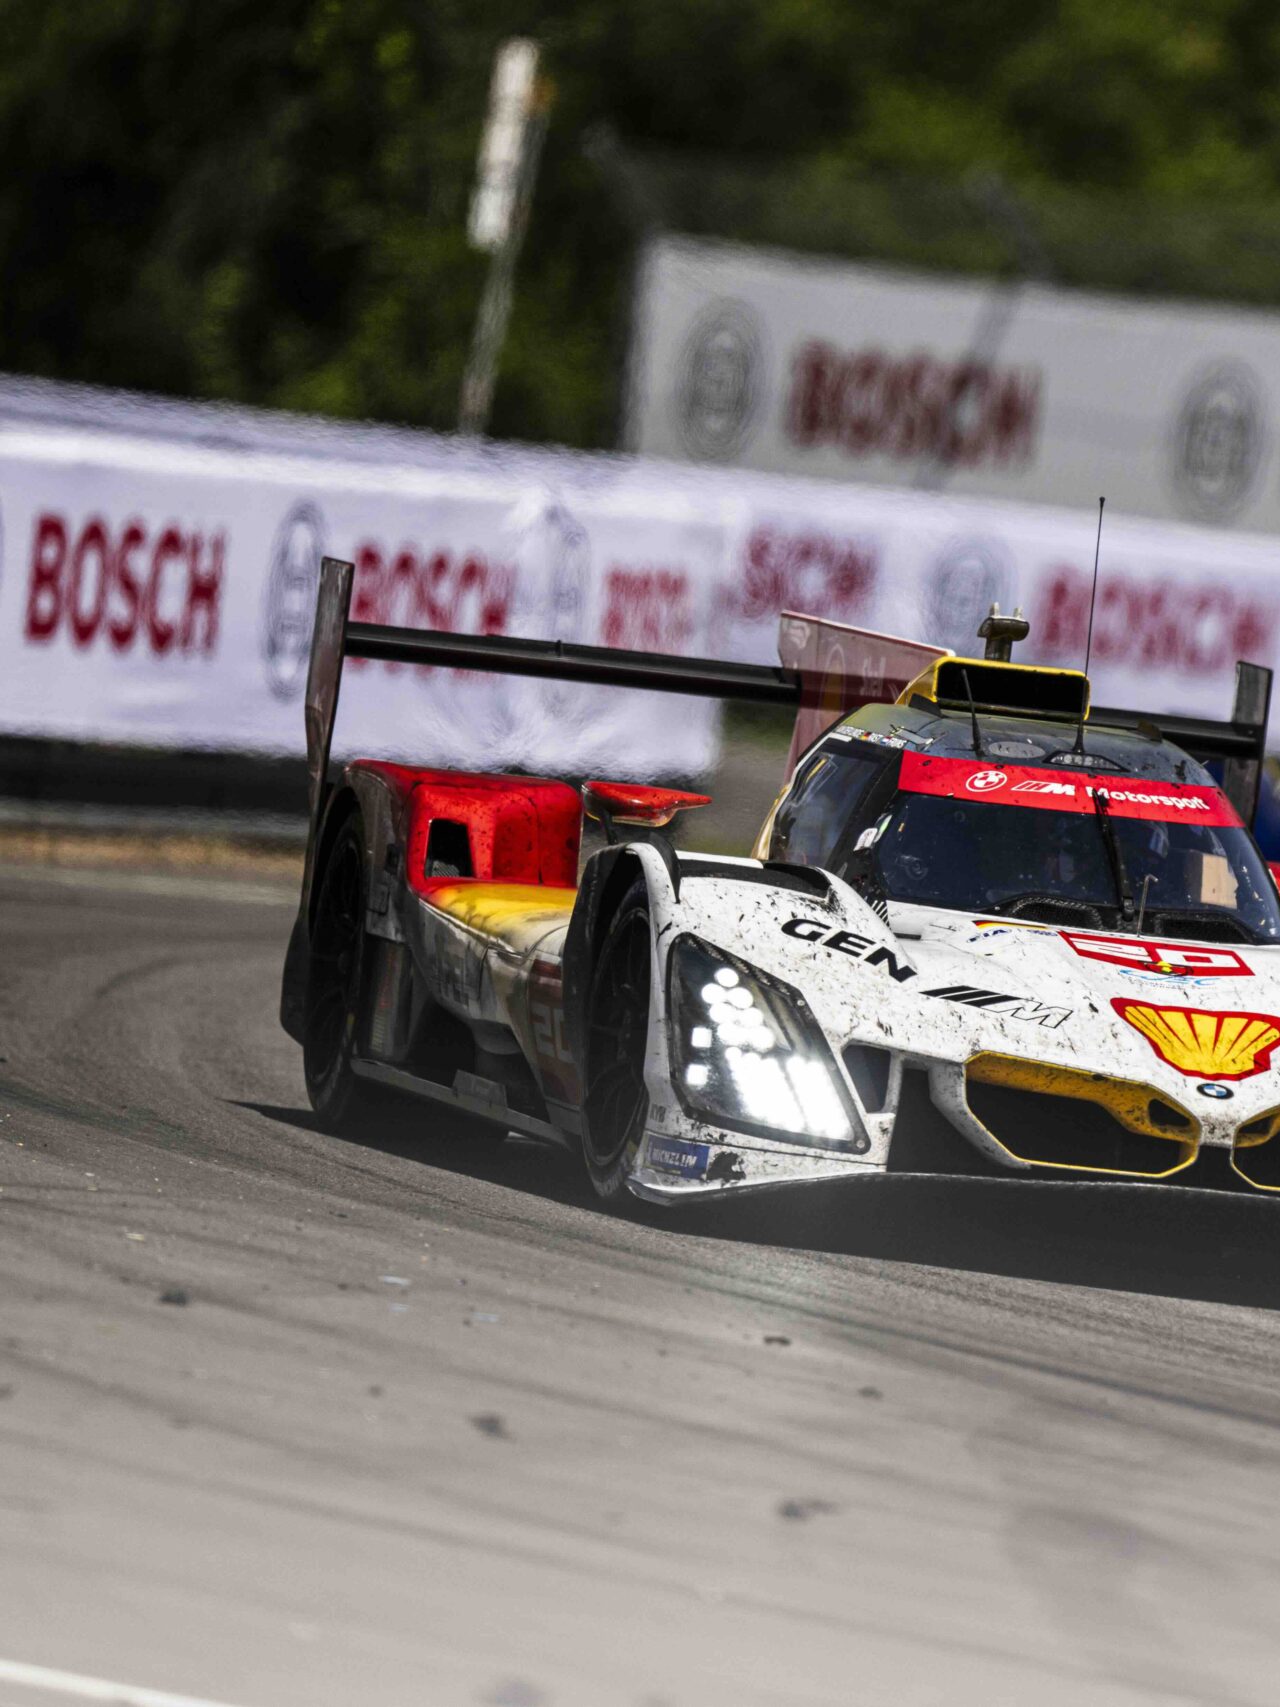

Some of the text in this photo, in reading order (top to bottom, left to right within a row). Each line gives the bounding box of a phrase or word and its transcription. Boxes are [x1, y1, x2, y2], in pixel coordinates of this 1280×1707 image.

[786, 341, 1043, 474] BOSCH
[24, 510, 227, 658] BOSCH
[1086, 785, 1211, 811] Motorsport
[780, 918, 918, 983] GEN
